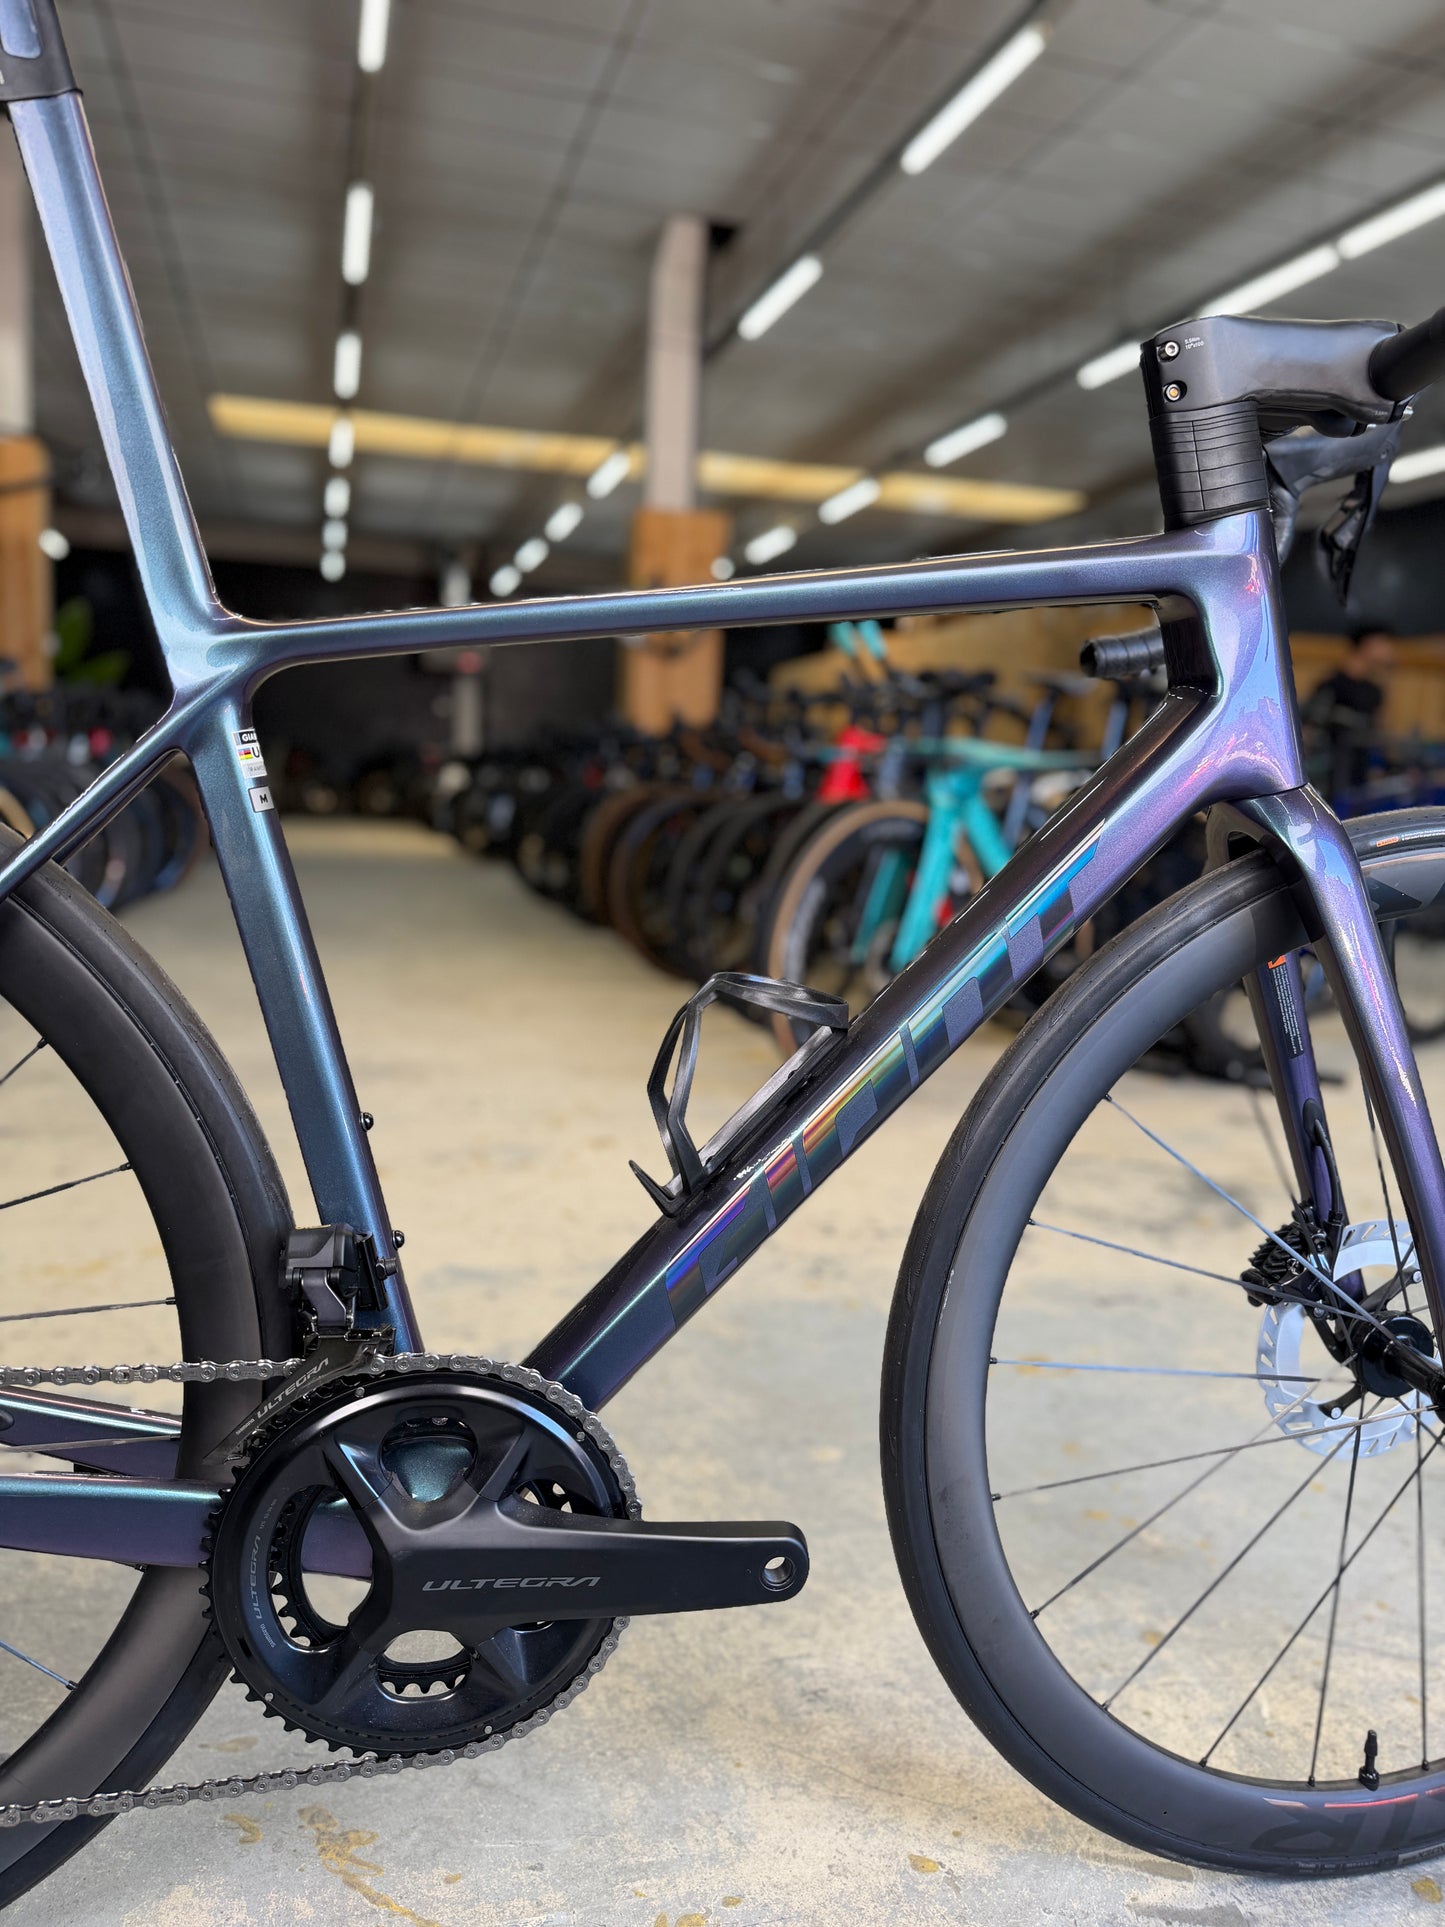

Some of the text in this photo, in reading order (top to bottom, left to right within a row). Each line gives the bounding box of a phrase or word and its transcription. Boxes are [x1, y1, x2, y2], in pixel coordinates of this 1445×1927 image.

[259, 793, 268, 804] M
[257, 1357, 329, 1419] ULTEGRA
[249, 1535, 263, 1620] ULTEGRA
[422, 1576, 601, 1592] ULTEGRA
